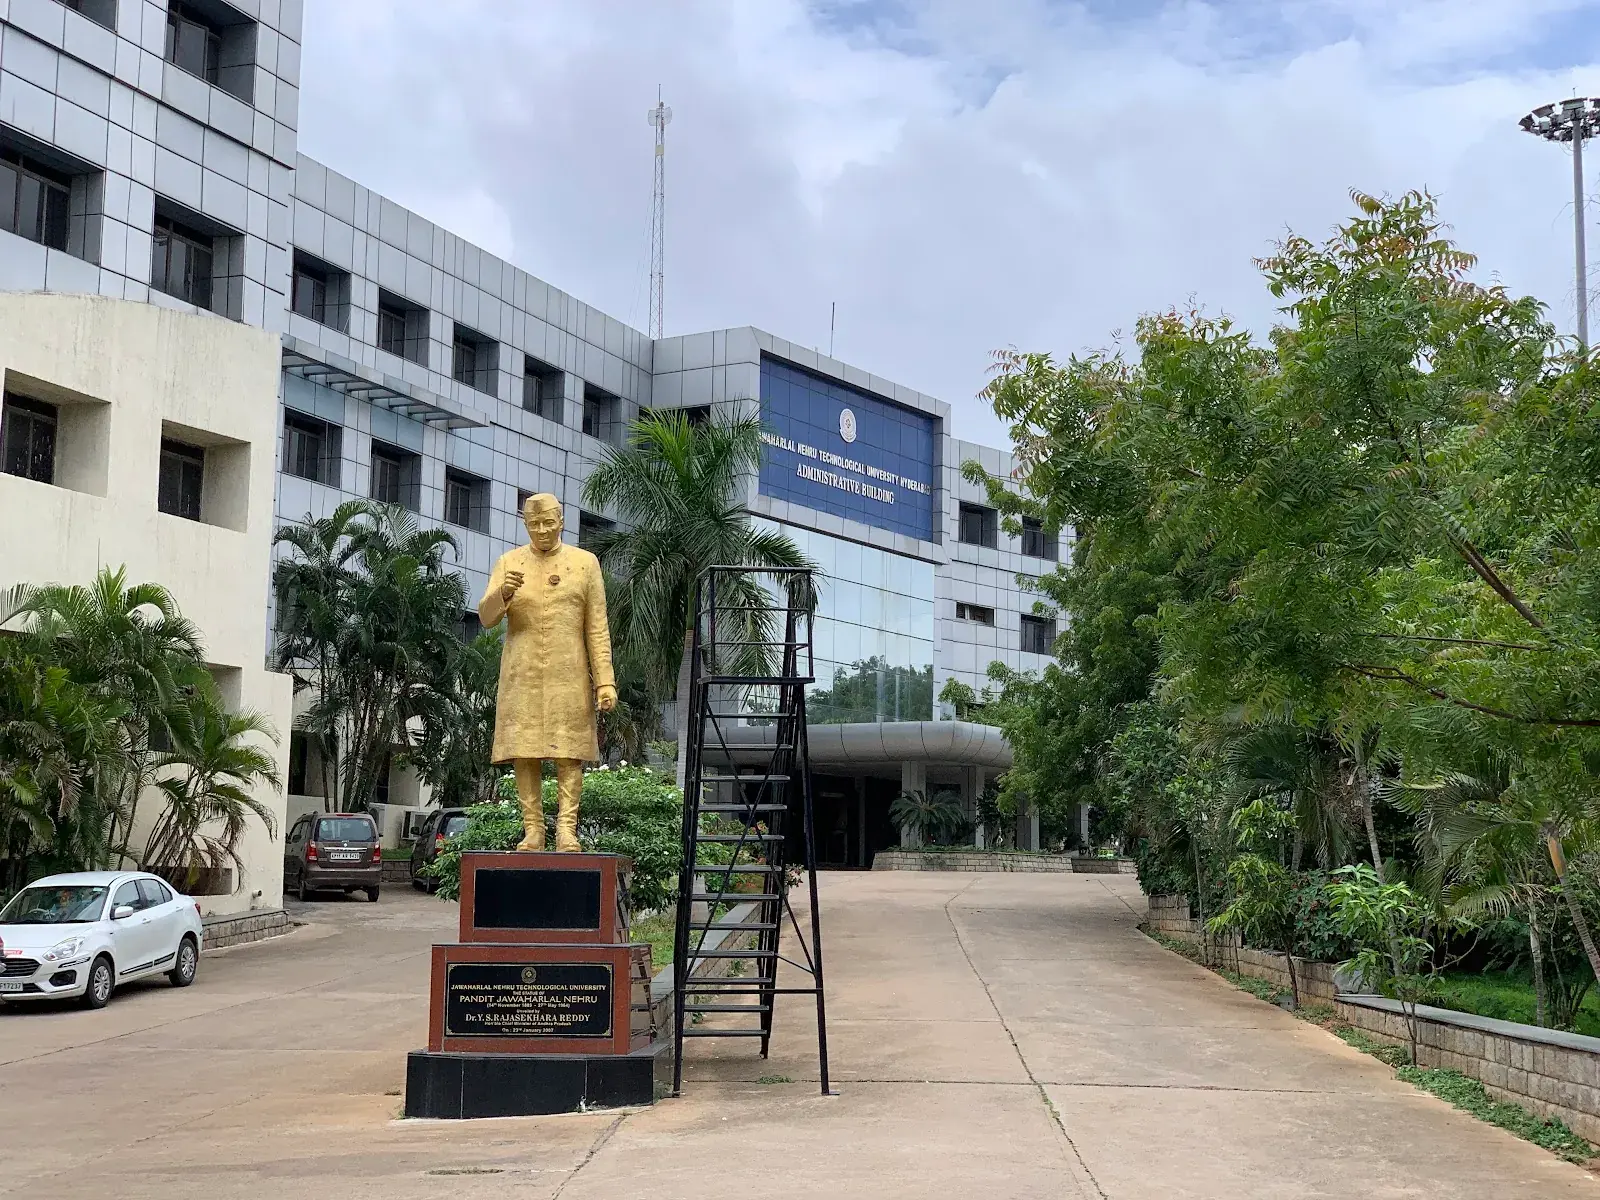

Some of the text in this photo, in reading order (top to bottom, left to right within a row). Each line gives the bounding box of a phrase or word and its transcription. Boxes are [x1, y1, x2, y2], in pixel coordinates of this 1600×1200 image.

[796, 463, 895, 505] ADMINISTRATIVE BUILDING
[798, 442, 818, 459] NEHRU
[819, 450, 866, 475] TECHNOLOGICAL
[866, 465, 899, 486] UNIVERSITY
[900, 476, 931, 496] HYDERABAD
[460, 995, 598, 1003] PANDIT JAWAHARLAL NEHRU
